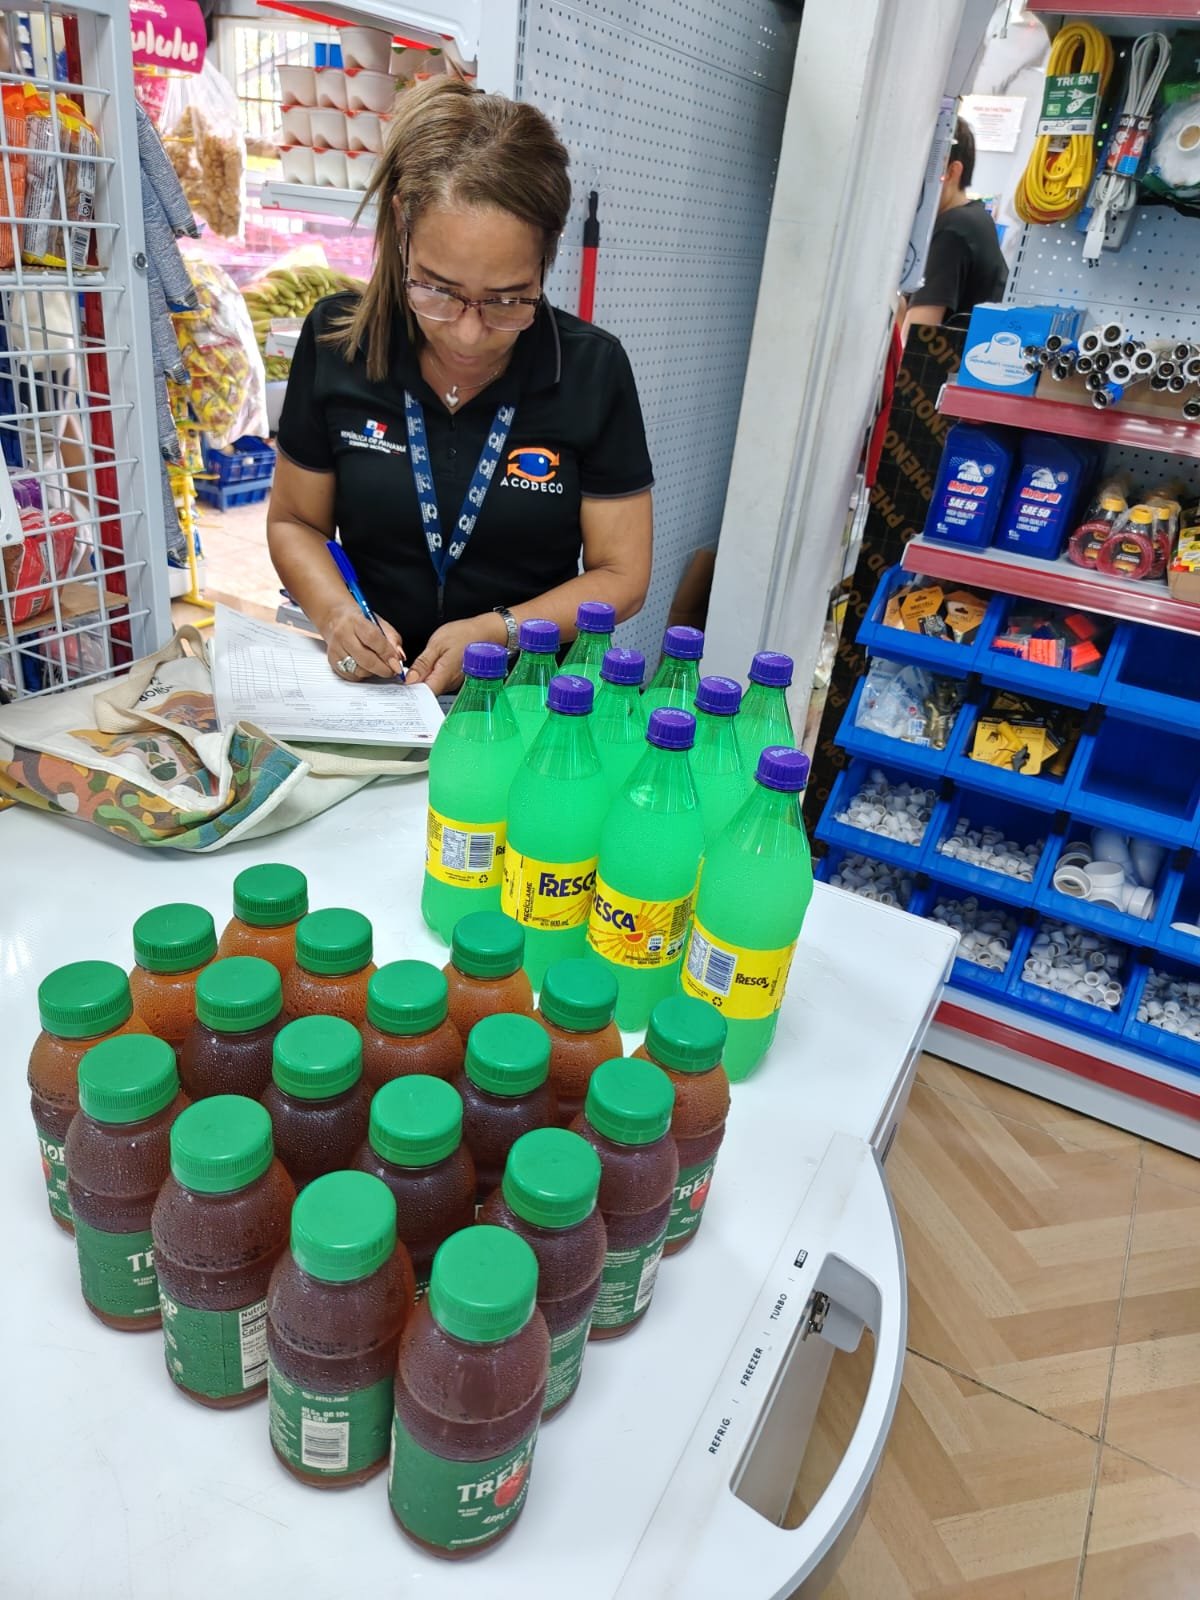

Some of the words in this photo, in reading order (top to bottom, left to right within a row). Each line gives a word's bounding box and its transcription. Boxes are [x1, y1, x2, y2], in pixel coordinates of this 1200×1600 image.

[499, 475, 564, 495] ACODECO
[948, 497, 965, 508] SAE
[1020, 504, 1038, 515] SAE
[593, 893, 637, 933] ESCA
[735, 972, 769, 989] FRESCA
[708, 1417, 733, 1455] REFRIG.
[740, 1347, 764, 1387] FREEZER
[769, 1293, 788, 1321] TURBO
